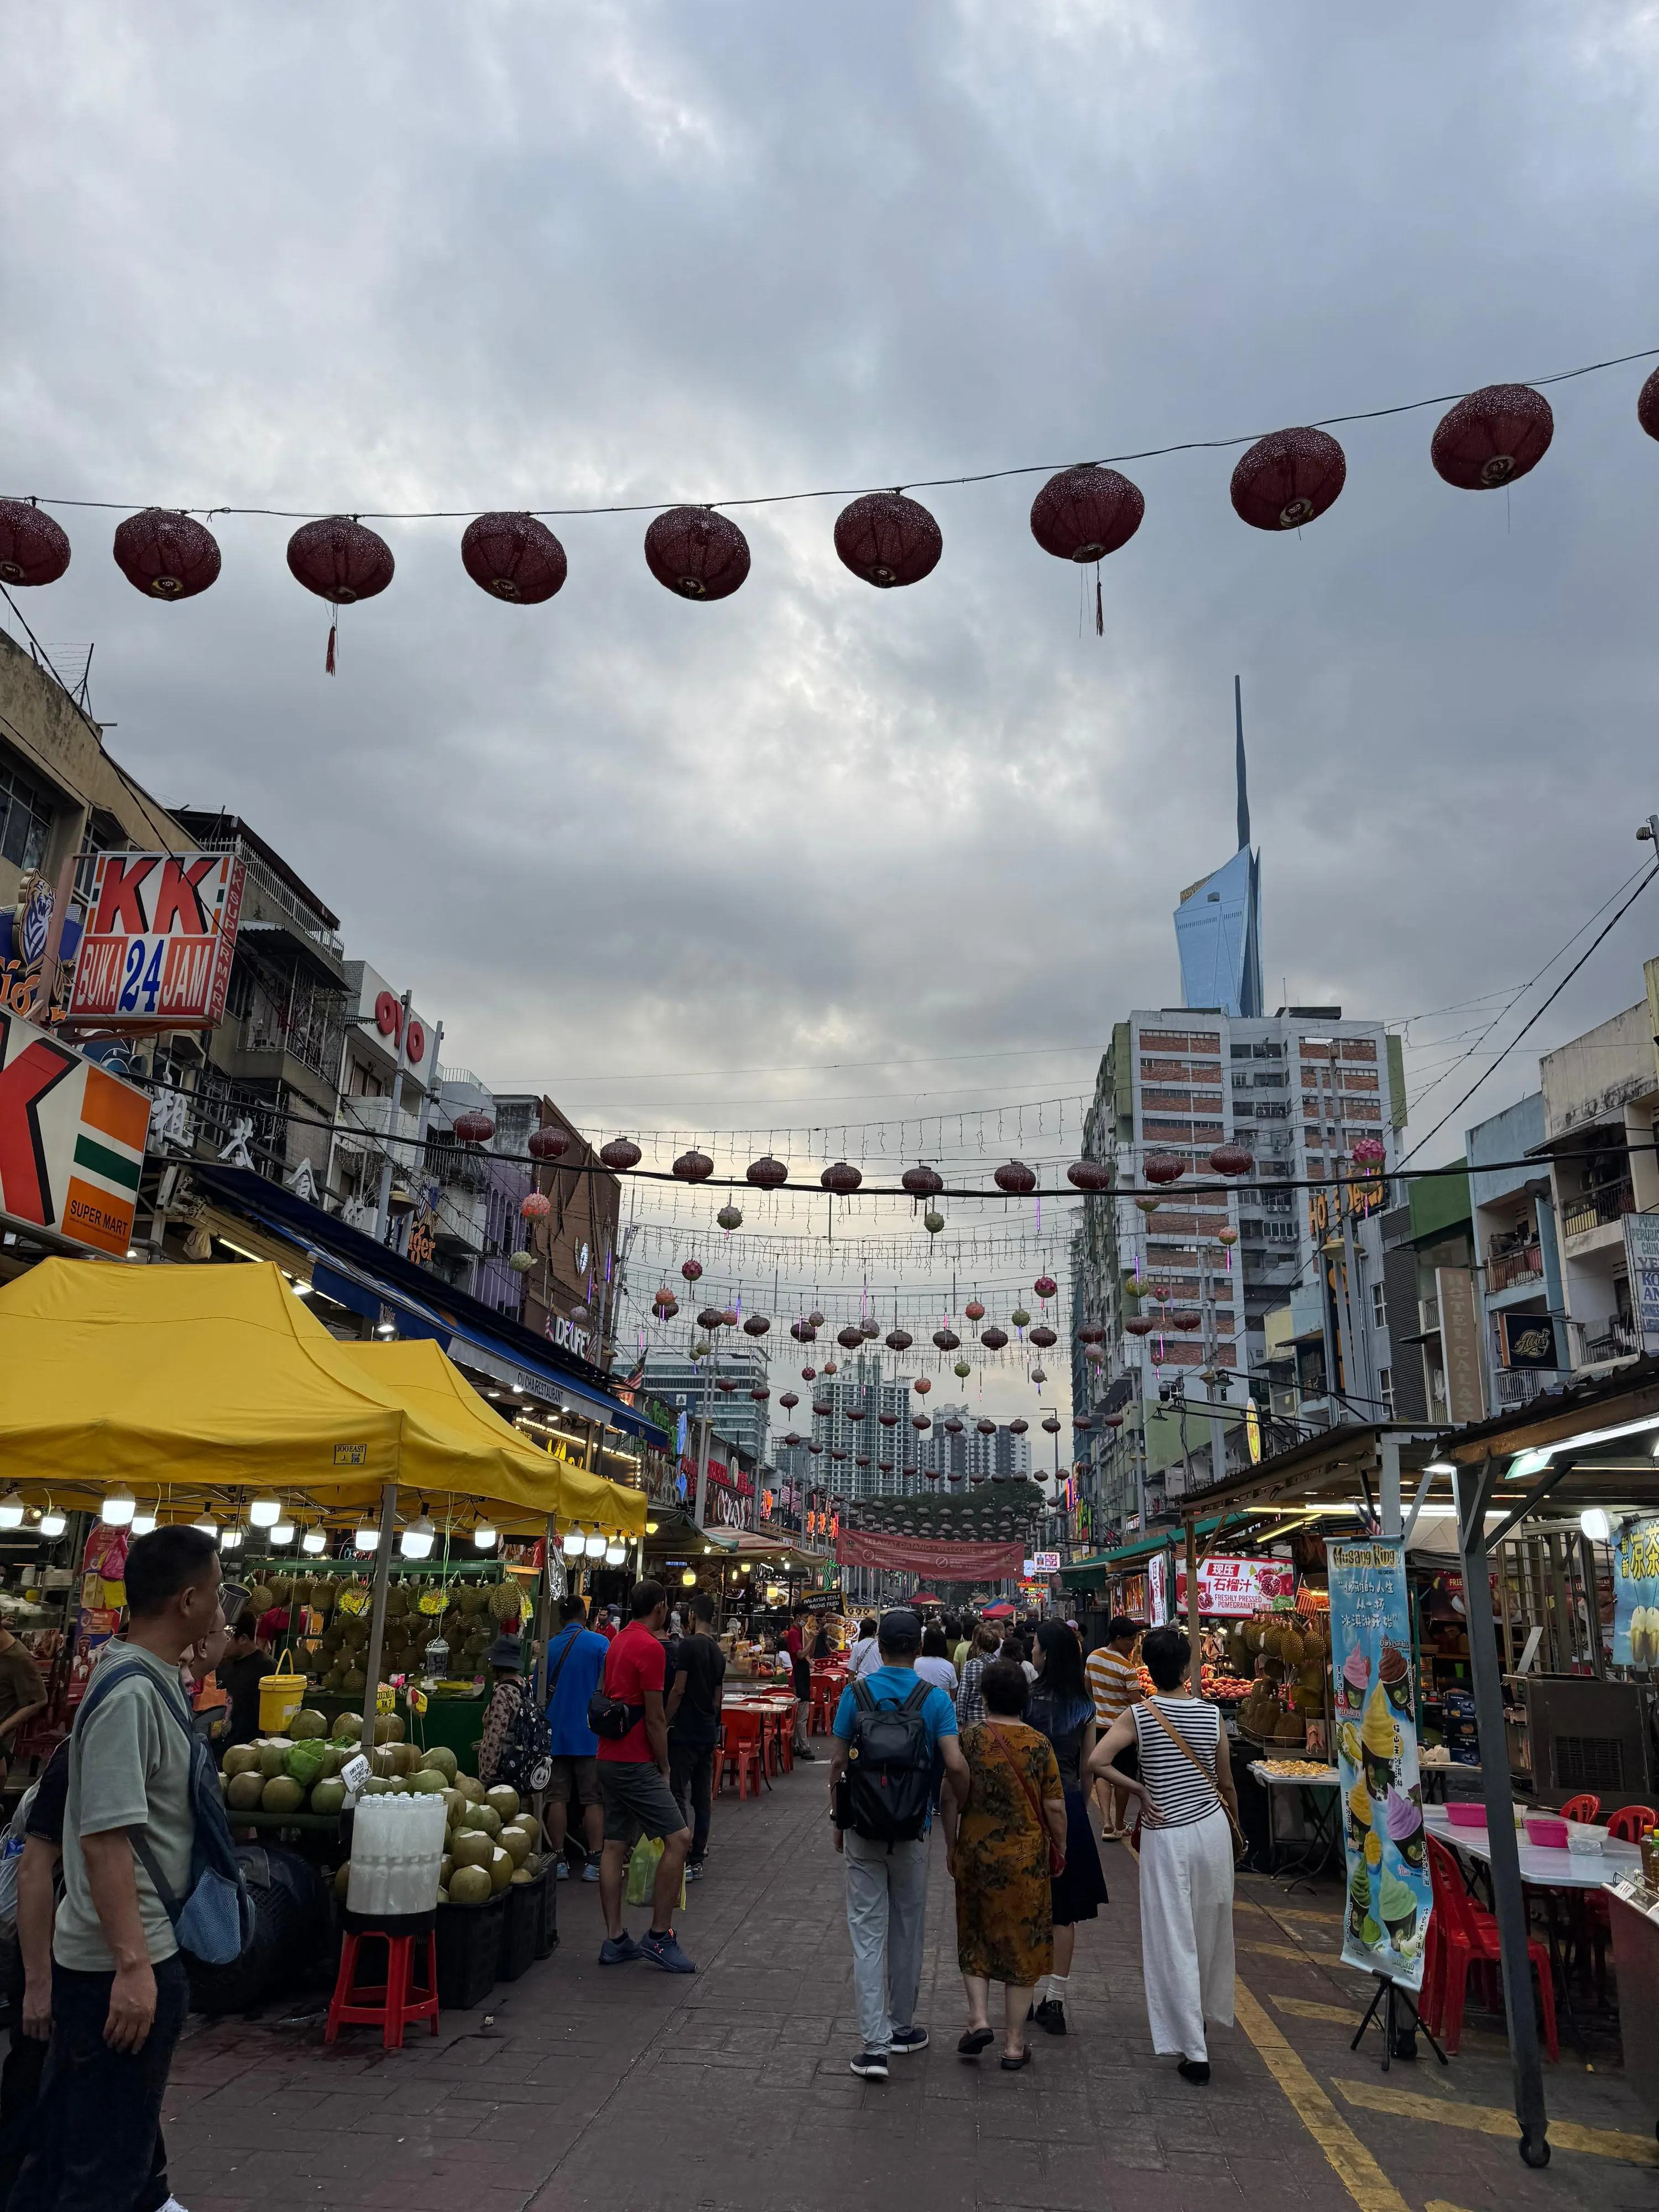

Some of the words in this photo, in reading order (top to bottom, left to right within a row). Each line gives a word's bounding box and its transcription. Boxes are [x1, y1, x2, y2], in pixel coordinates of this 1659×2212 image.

[95, 857, 222, 935] KK
[75, 943, 122, 1006] BUKA
[118, 940, 165, 1013] 24
[162, 945, 210, 1008] JAM
[70, 1199, 102, 1226] SUPER
[103, 1213, 128, 1237] MART
[1639, 1215, 1659, 1228] PUSA
[408, 1221, 436, 1265] iger
[1637, 1256, 1659, 1271] YE
[1446, 1274, 1467, 1339] HOTEL
[518, 1372, 525, 1387] CU
[525, 1376, 535, 1392] CHA
[535, 1379, 564, 1404] RESTAURANT
[864, 1537, 898, 1548] SELAMAT
[900, 1542, 931, 1551] DATANG
[937, 1545, 976, 1554] WELCOME
[1333, 1546, 1371, 1566] Musang
[1373, 1543, 1396, 1566] King
[1629, 1521, 1659, 1581] 凉茶
[1212, 1564, 1234, 1575] 现压
[1213, 1578, 1252, 1593] 石榴汁
[1218, 1601, 1256, 1610] POMEGRANATE
[1238, 1595, 1262, 1603] PRESSED
